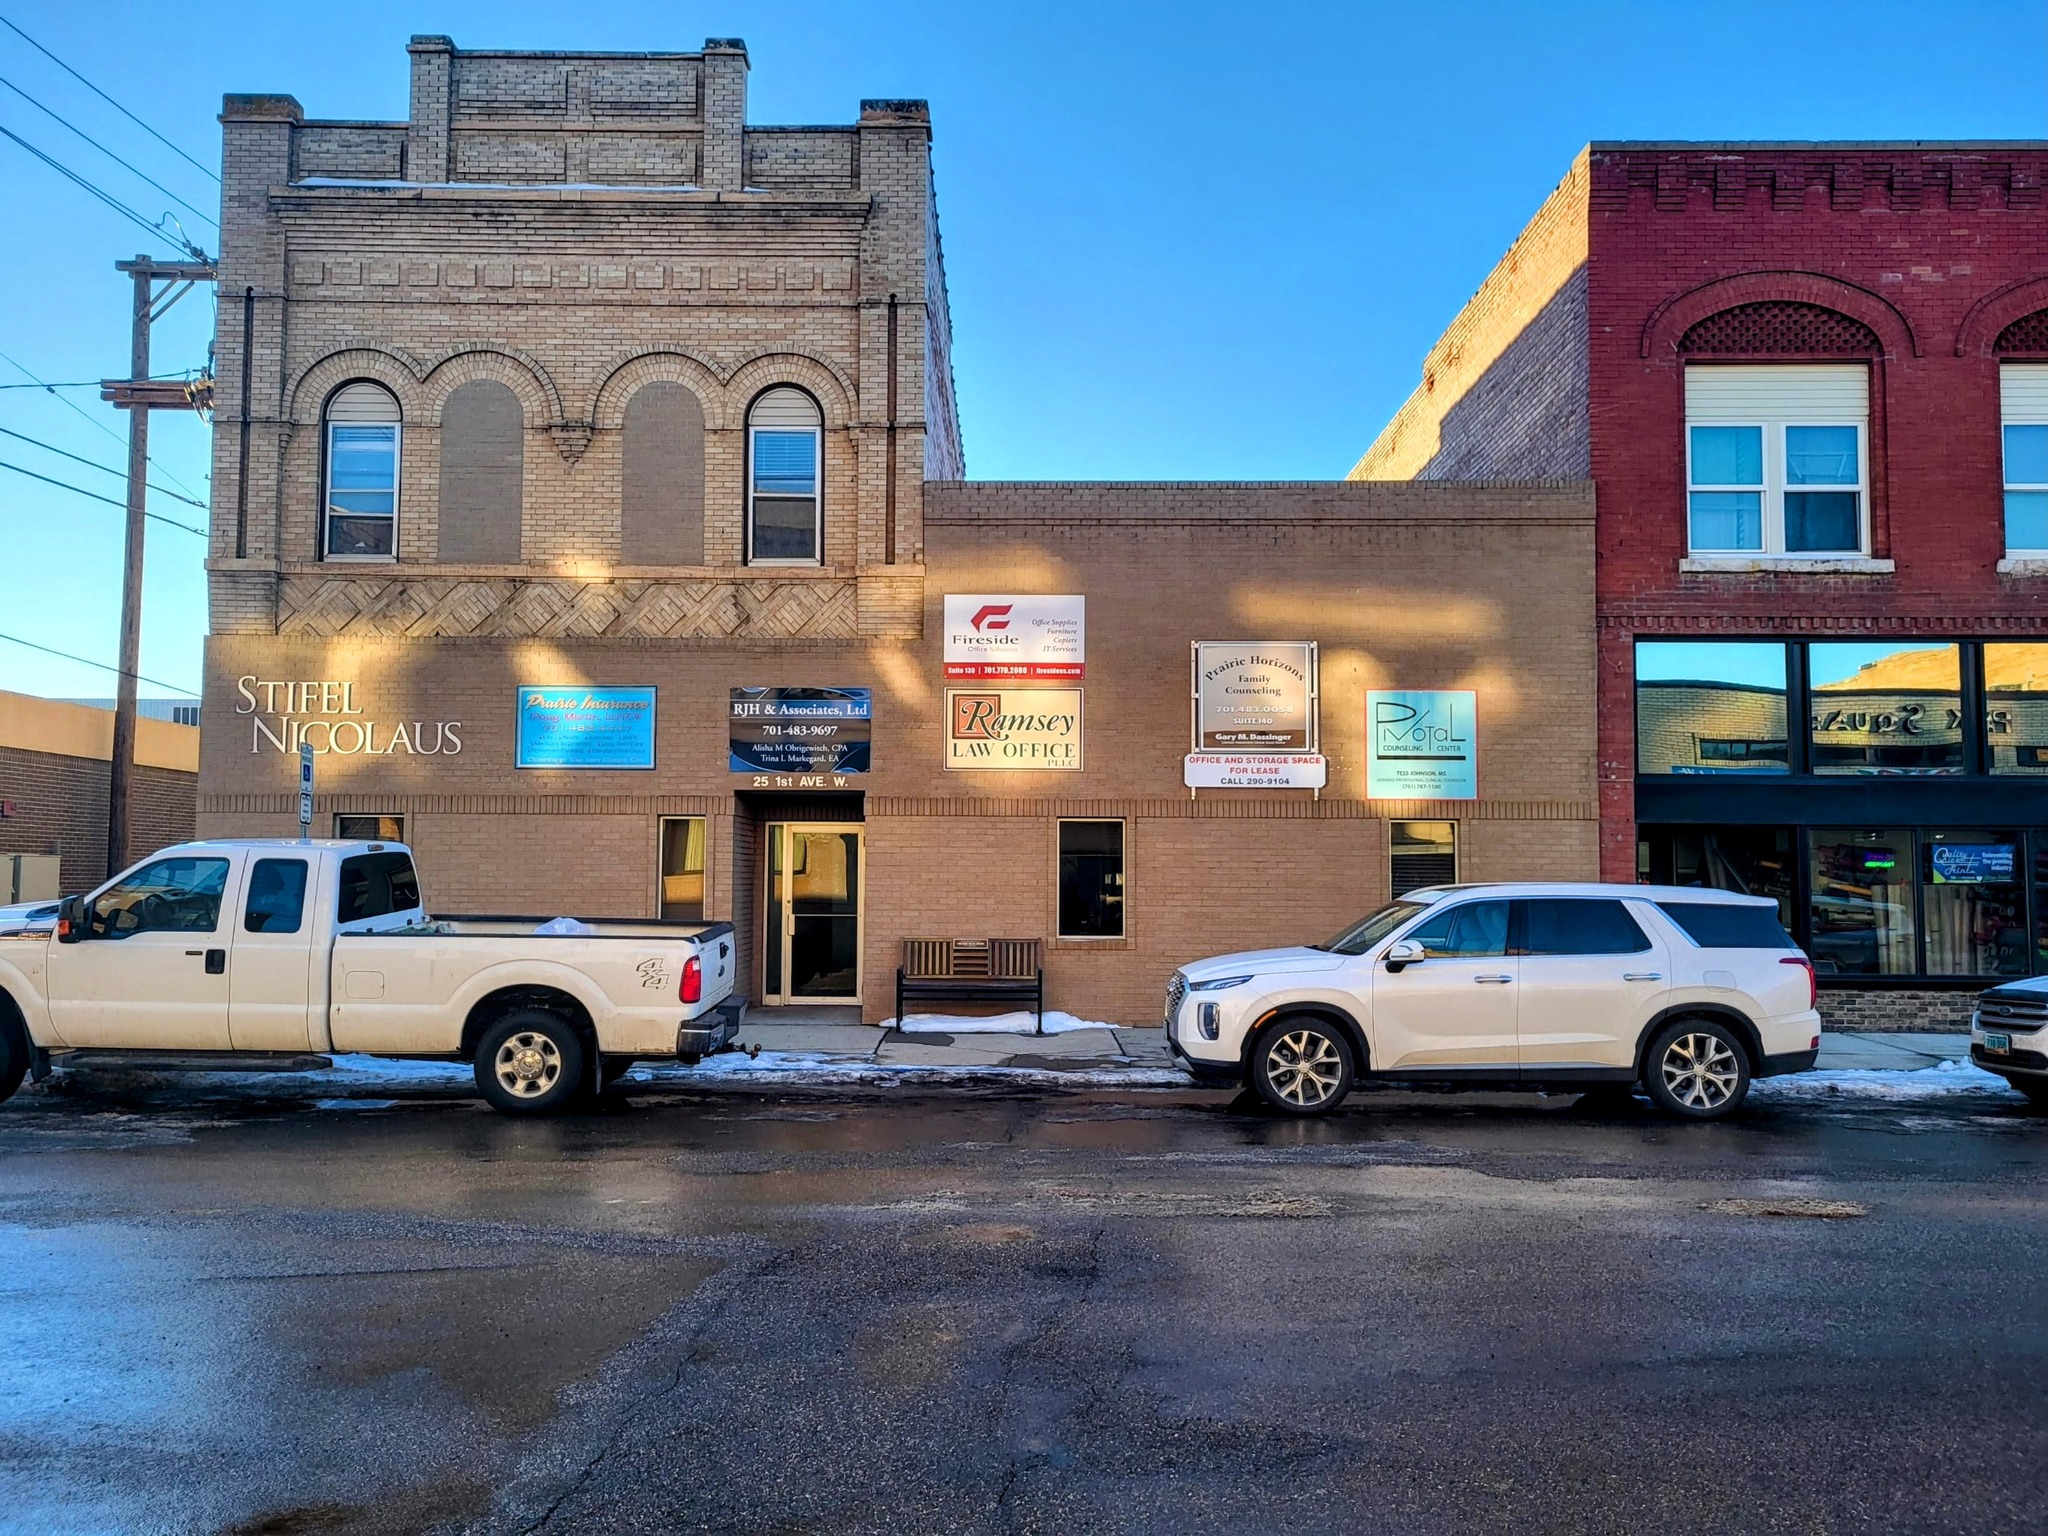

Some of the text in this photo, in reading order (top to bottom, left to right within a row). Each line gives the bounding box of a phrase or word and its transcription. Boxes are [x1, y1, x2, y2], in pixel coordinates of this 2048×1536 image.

[952, 635, 1020, 645] Fireside
[948, 666, 963, 674] Suite
[1204, 655, 1305, 682] Prairie Horizons
[1238, 674, 1271, 685] Family
[235, 675, 363, 715] STIFEL
[1225, 686, 1282, 697] Counseling
[526, 693, 650, 710] Prairie Insurance
[733, 703, 868, 717] RJH & Associates, Ltd
[530, 713, 559, 722] Doug
[961, 700, 1075, 741] Ramsey
[1232, 717, 1274, 725] SUITE 140
[249, 715, 463, 756] NICOLAUS
[762, 725, 838, 736] 701-483-9697
[1215, 733, 1237, 742] Gary
[1250, 733, 1292, 742] Dassinger
[751, 744, 773, 752] Alisha
[775, 744, 783, 752] M
[832, 744, 848, 752] CPA
[952, 742, 1076, 758] LAW OFFICE
[760, 754, 779, 762] Trina
[788, 754, 827, 763] Markegard,
[828, 754, 839, 762] EA
[1047, 759, 1076, 767] PLLC
[753, 776, 848, 787] 25 1st AVE. W.
